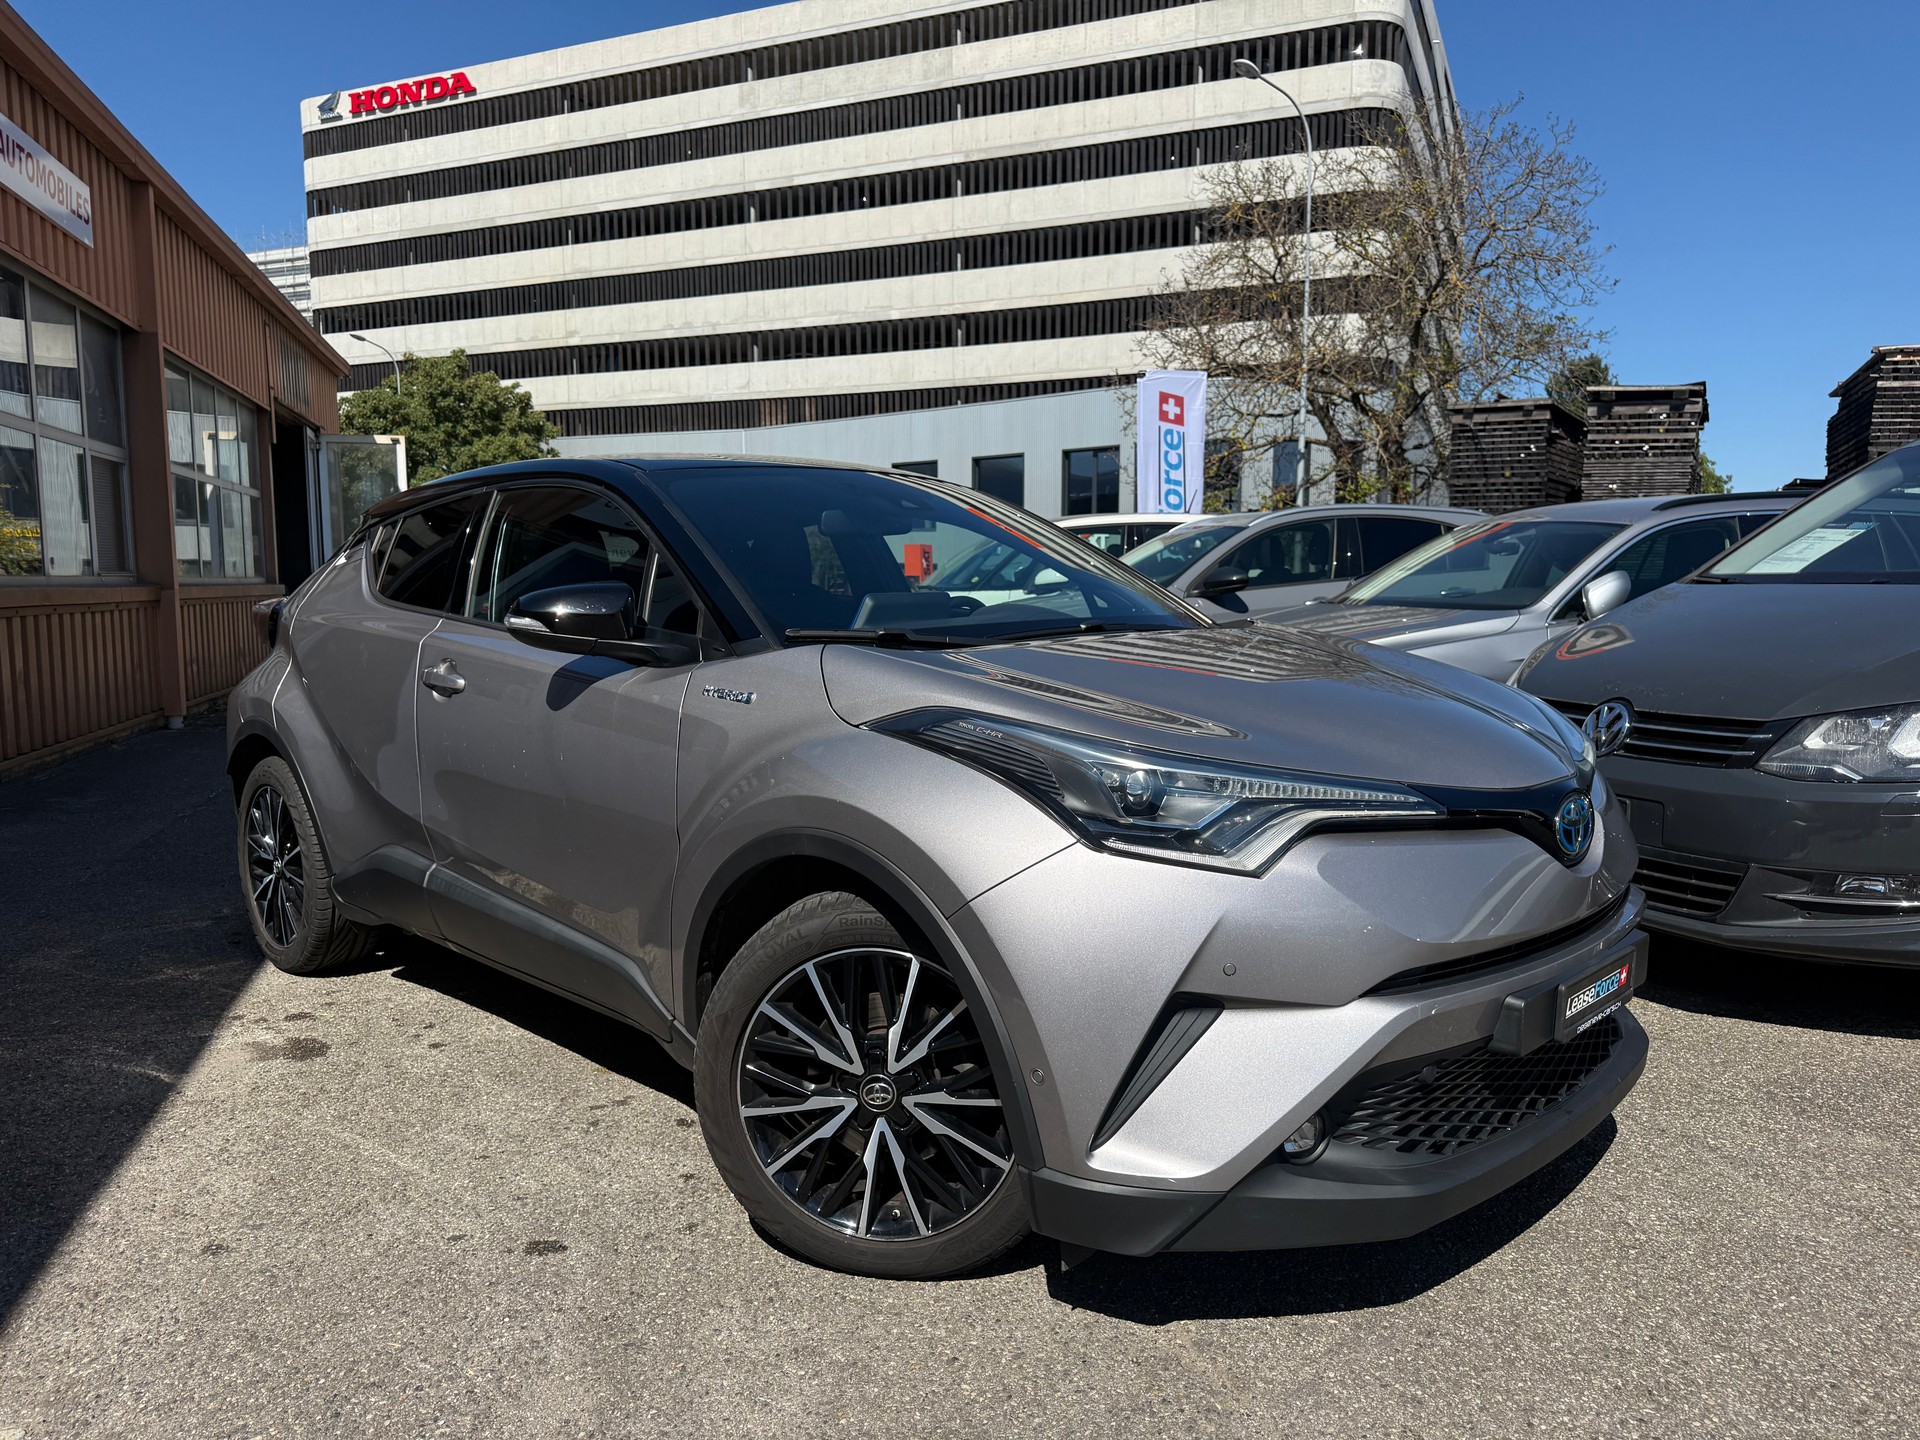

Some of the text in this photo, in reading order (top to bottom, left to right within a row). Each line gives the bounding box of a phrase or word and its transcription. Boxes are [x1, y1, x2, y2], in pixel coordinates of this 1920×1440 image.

[348, 72, 476, 114] HONDA
[1159, 428, 1183, 513] orce
[976, 726, 1003, 739] C-HR
[1566, 973, 1620, 1017] LeaseForce
